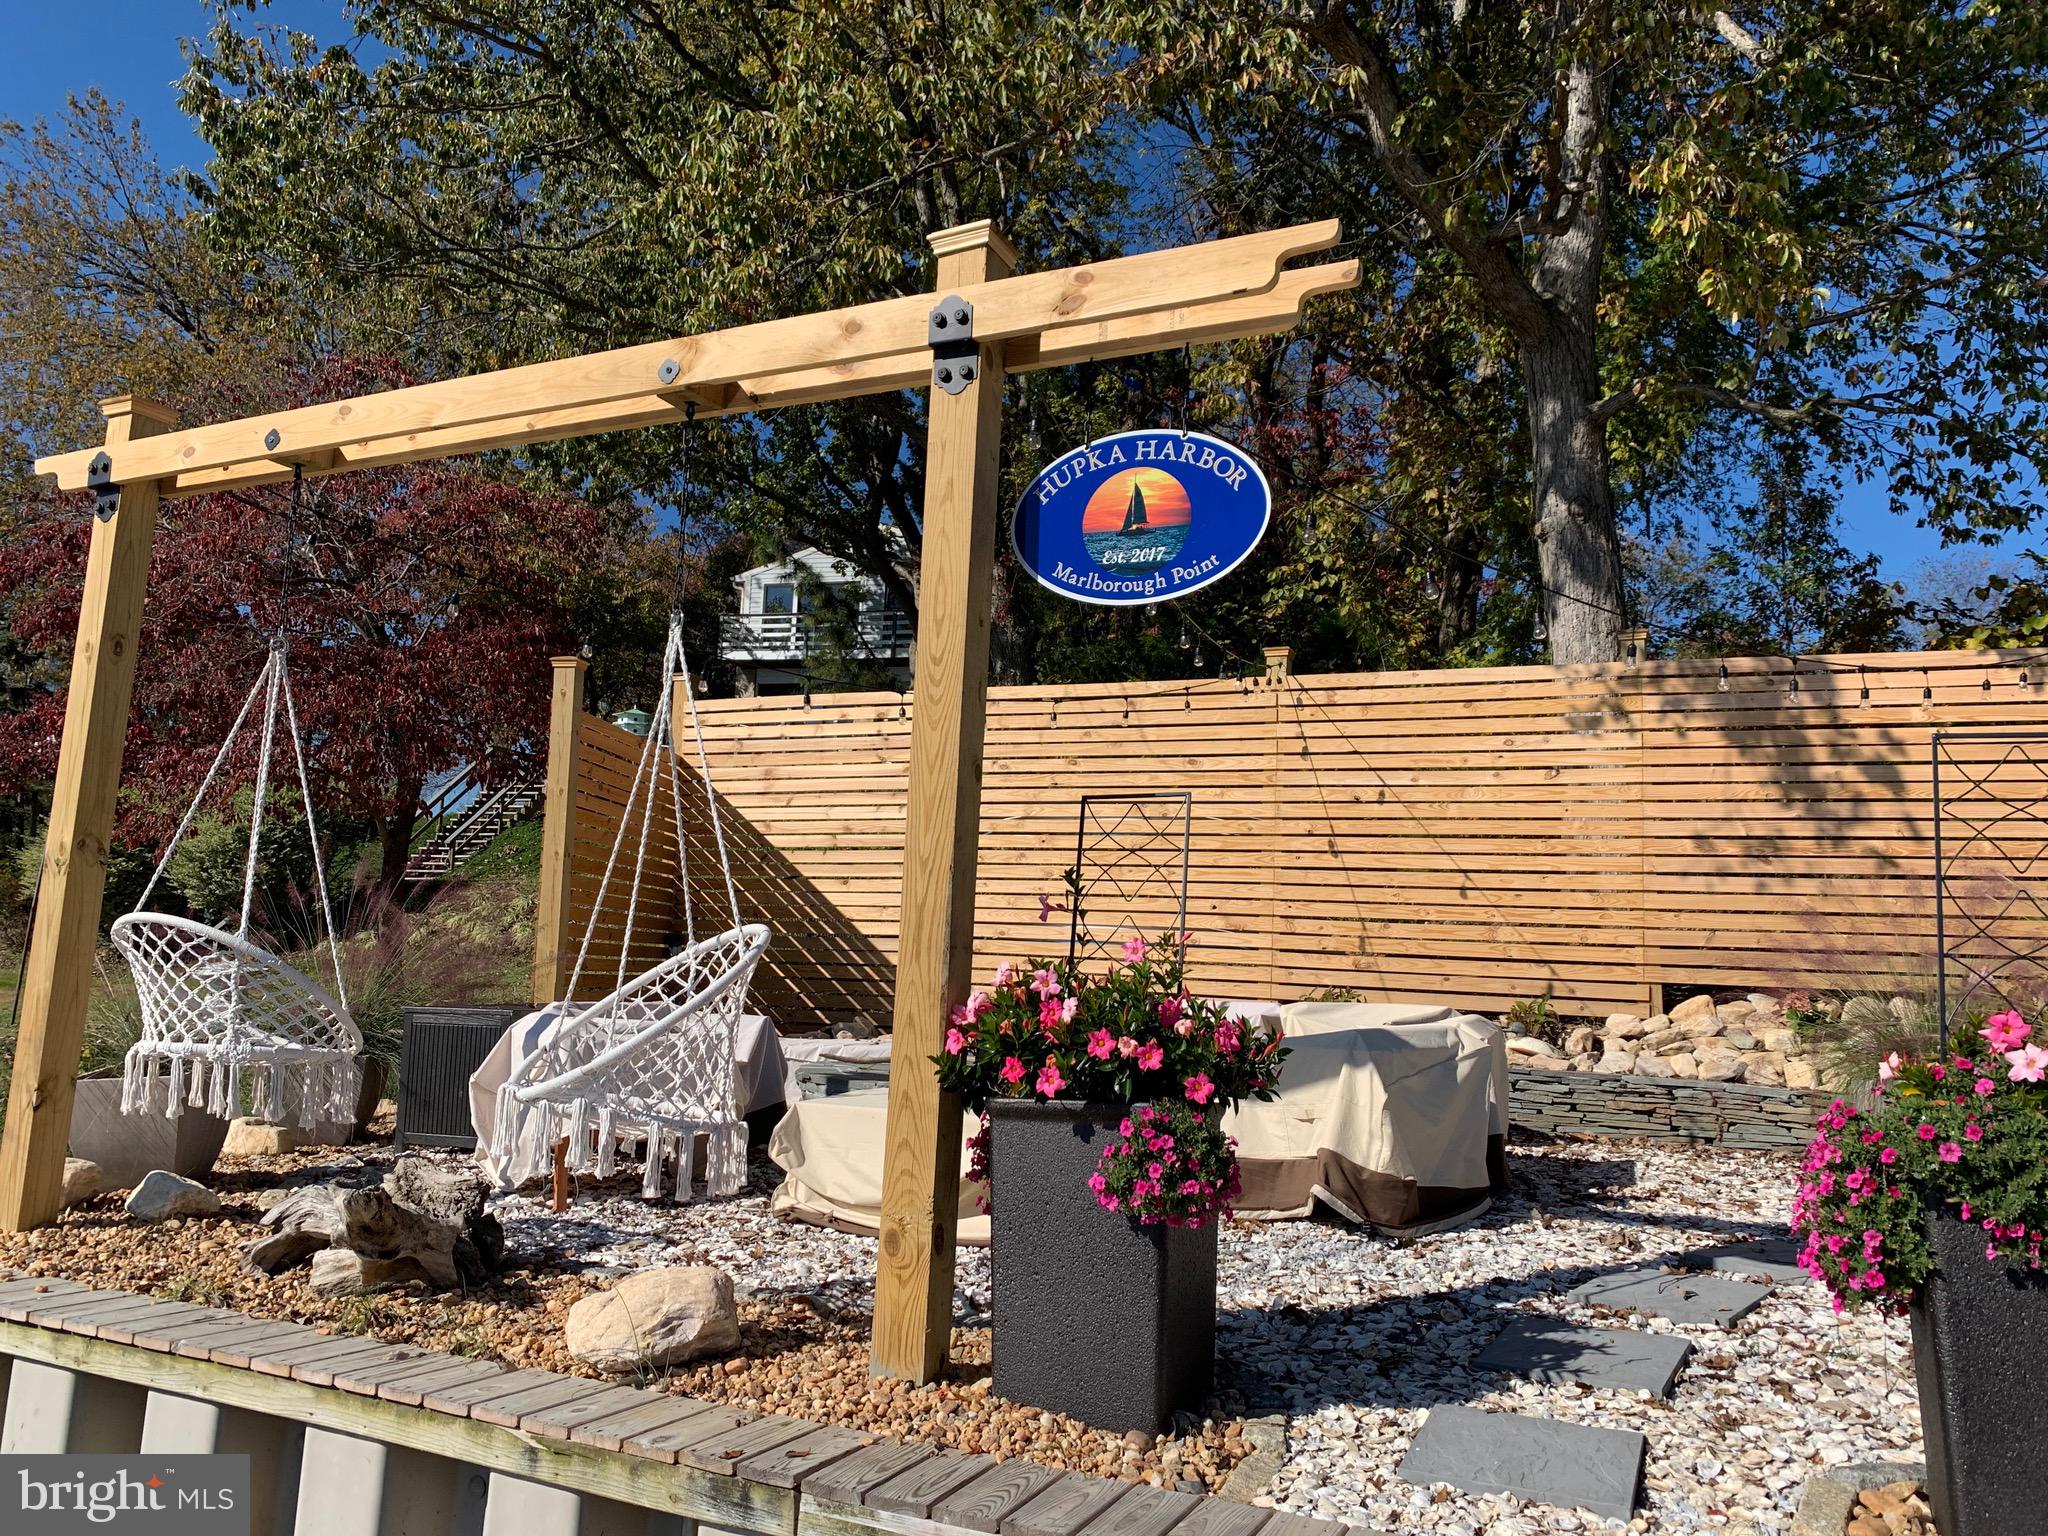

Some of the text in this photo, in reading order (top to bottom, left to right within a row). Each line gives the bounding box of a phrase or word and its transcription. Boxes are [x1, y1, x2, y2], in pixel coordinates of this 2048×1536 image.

[1033, 440, 1248, 505] HUPKA HARBOR
[1052, 554, 1220, 594] Marlborough Point
[1102, 546, 1165, 565] Est. 2017
